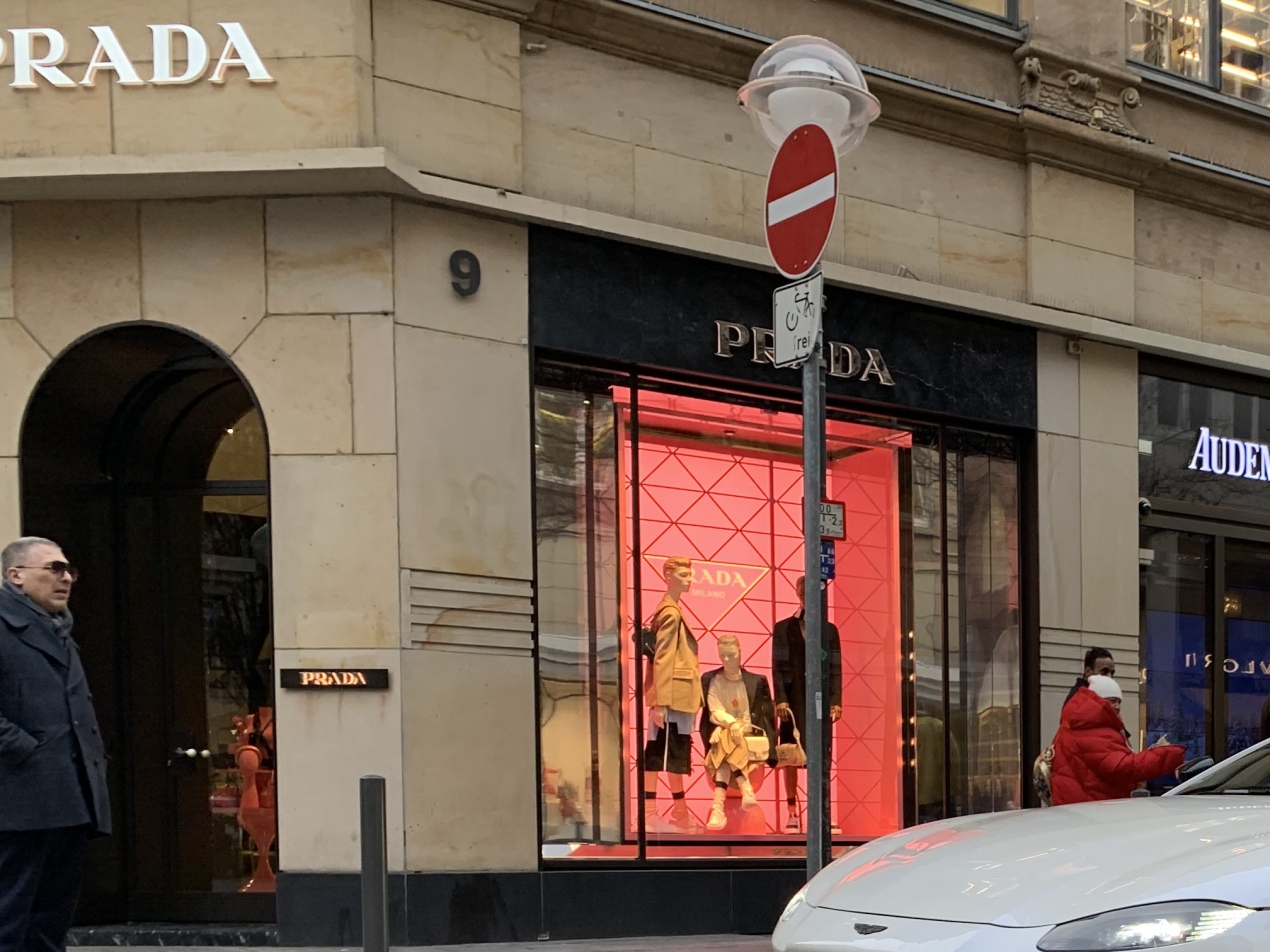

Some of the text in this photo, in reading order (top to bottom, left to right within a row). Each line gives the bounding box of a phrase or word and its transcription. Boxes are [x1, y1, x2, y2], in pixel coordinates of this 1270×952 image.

[0, 22, 275, 88] RADA
[449, 249, 481, 297] 9
[714, 320, 896, 386] PRDA
[689, 567, 748, 588] RADA
[299, 671, 367, 686] PRADA
